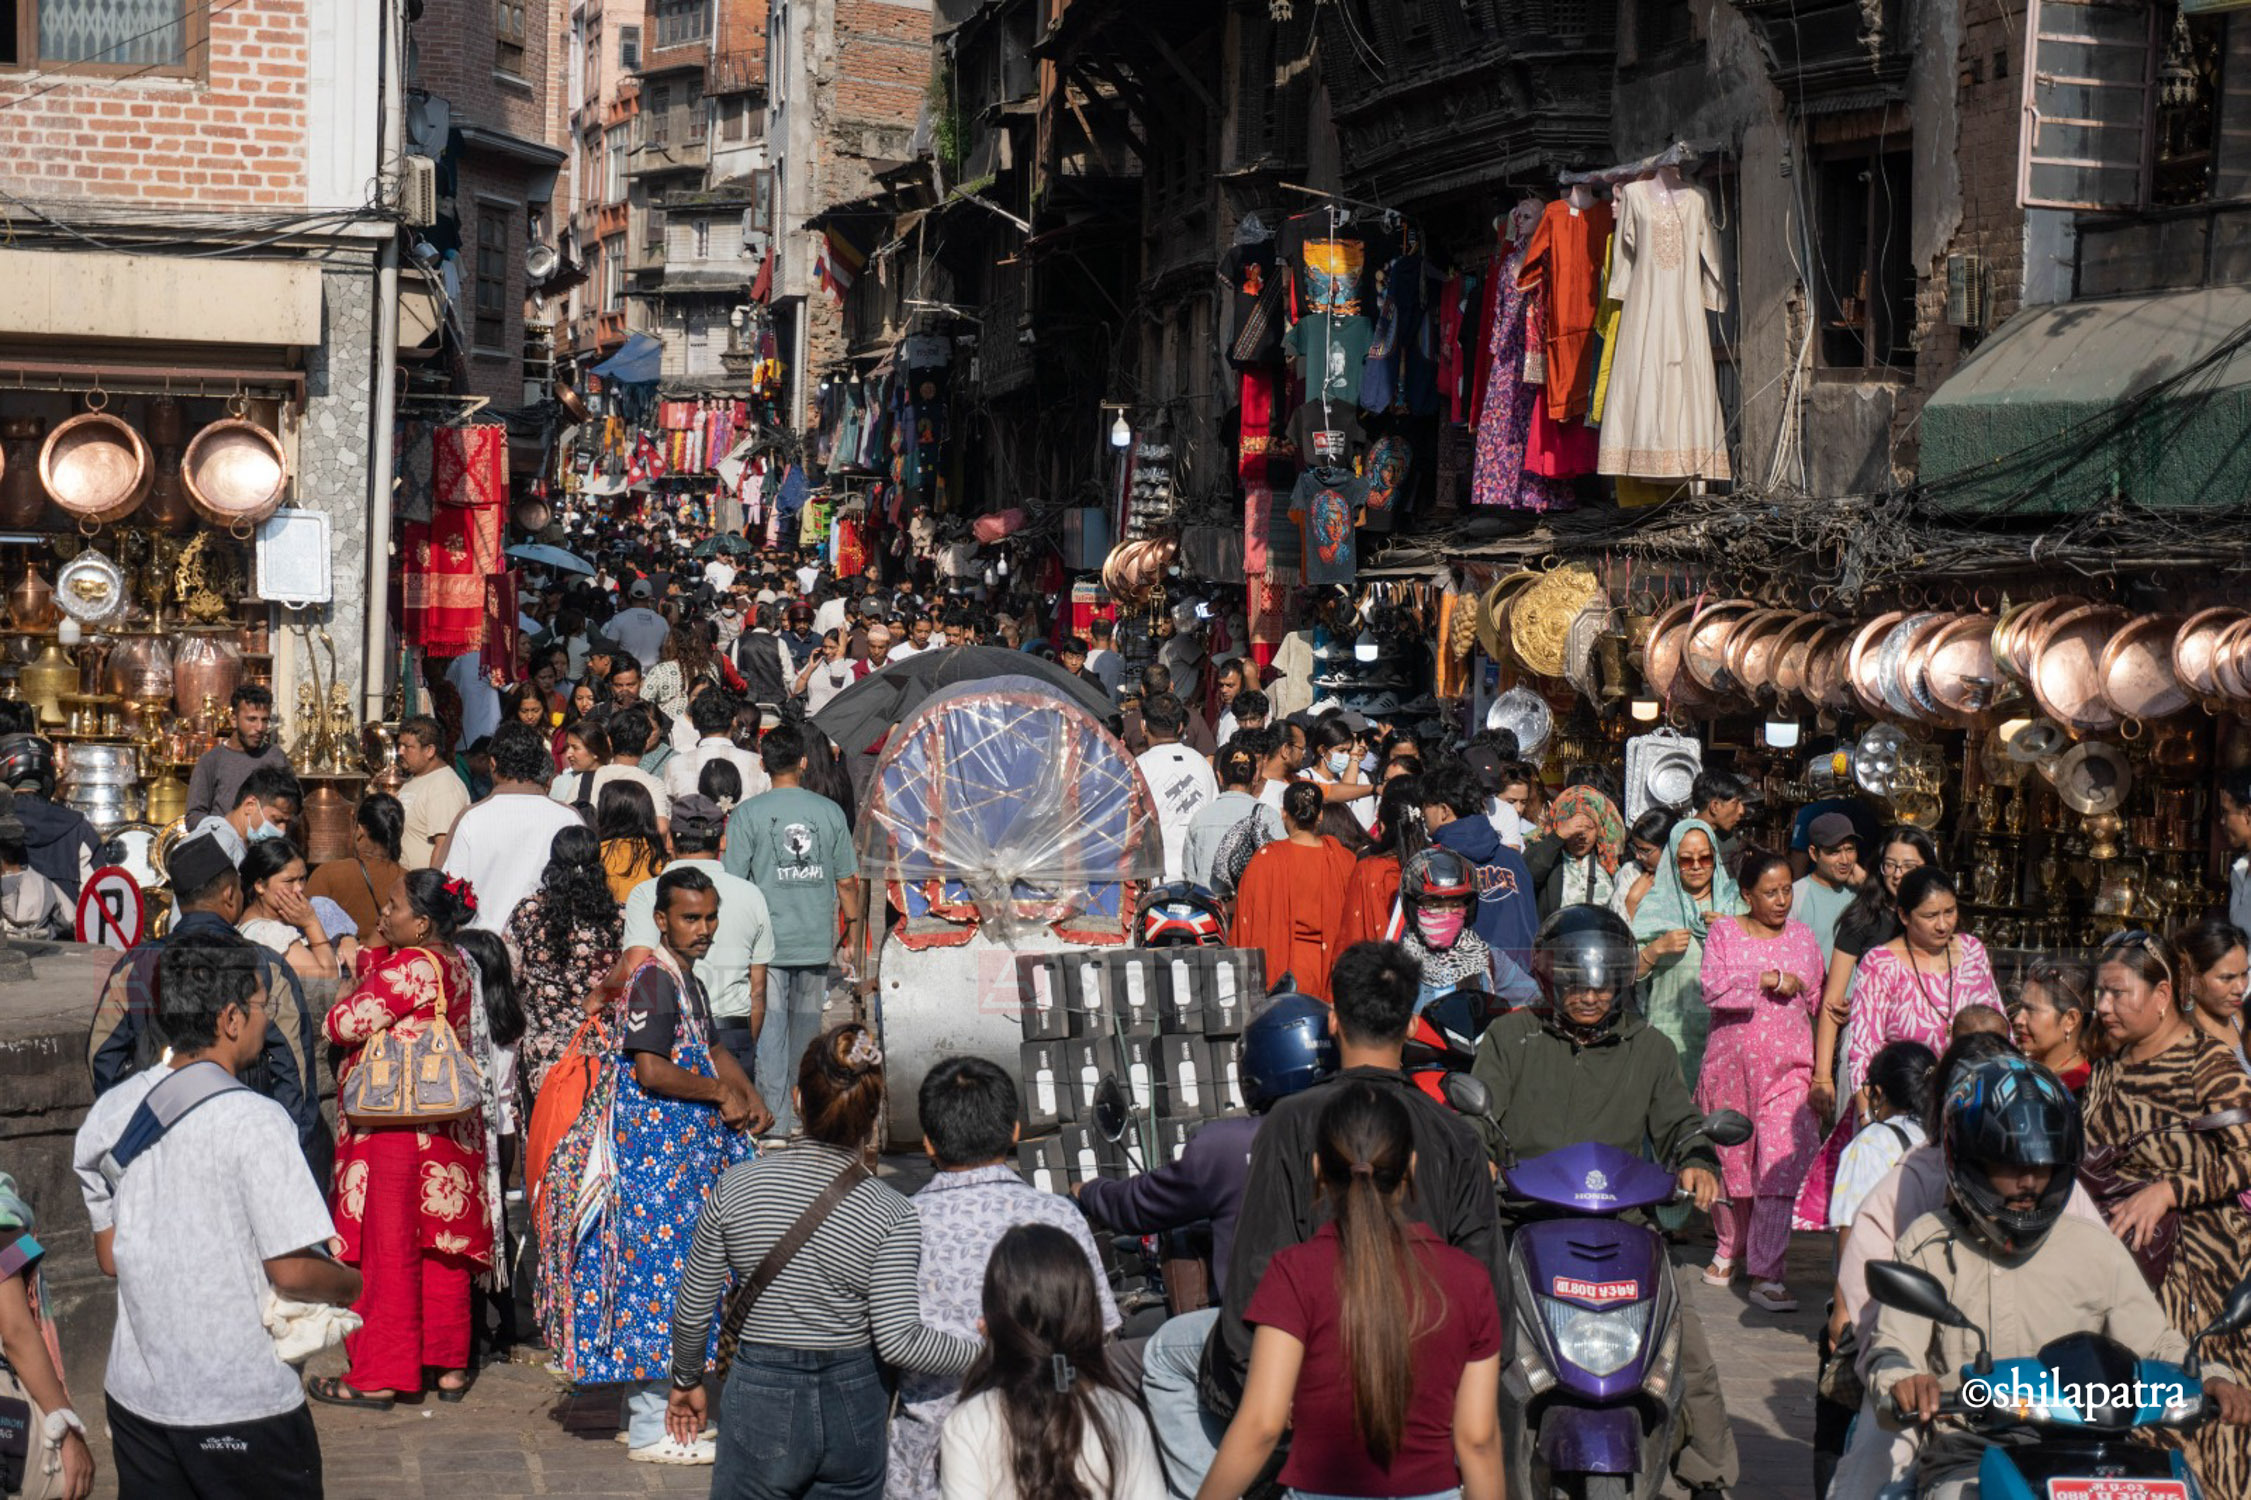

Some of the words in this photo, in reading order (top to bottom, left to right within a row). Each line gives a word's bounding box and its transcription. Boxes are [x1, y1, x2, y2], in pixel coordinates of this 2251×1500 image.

[777, 865, 824, 881] ITACHI
[1475, 864, 1518, 893] IKE
[1575, 1192, 1618, 1201] HONDA
